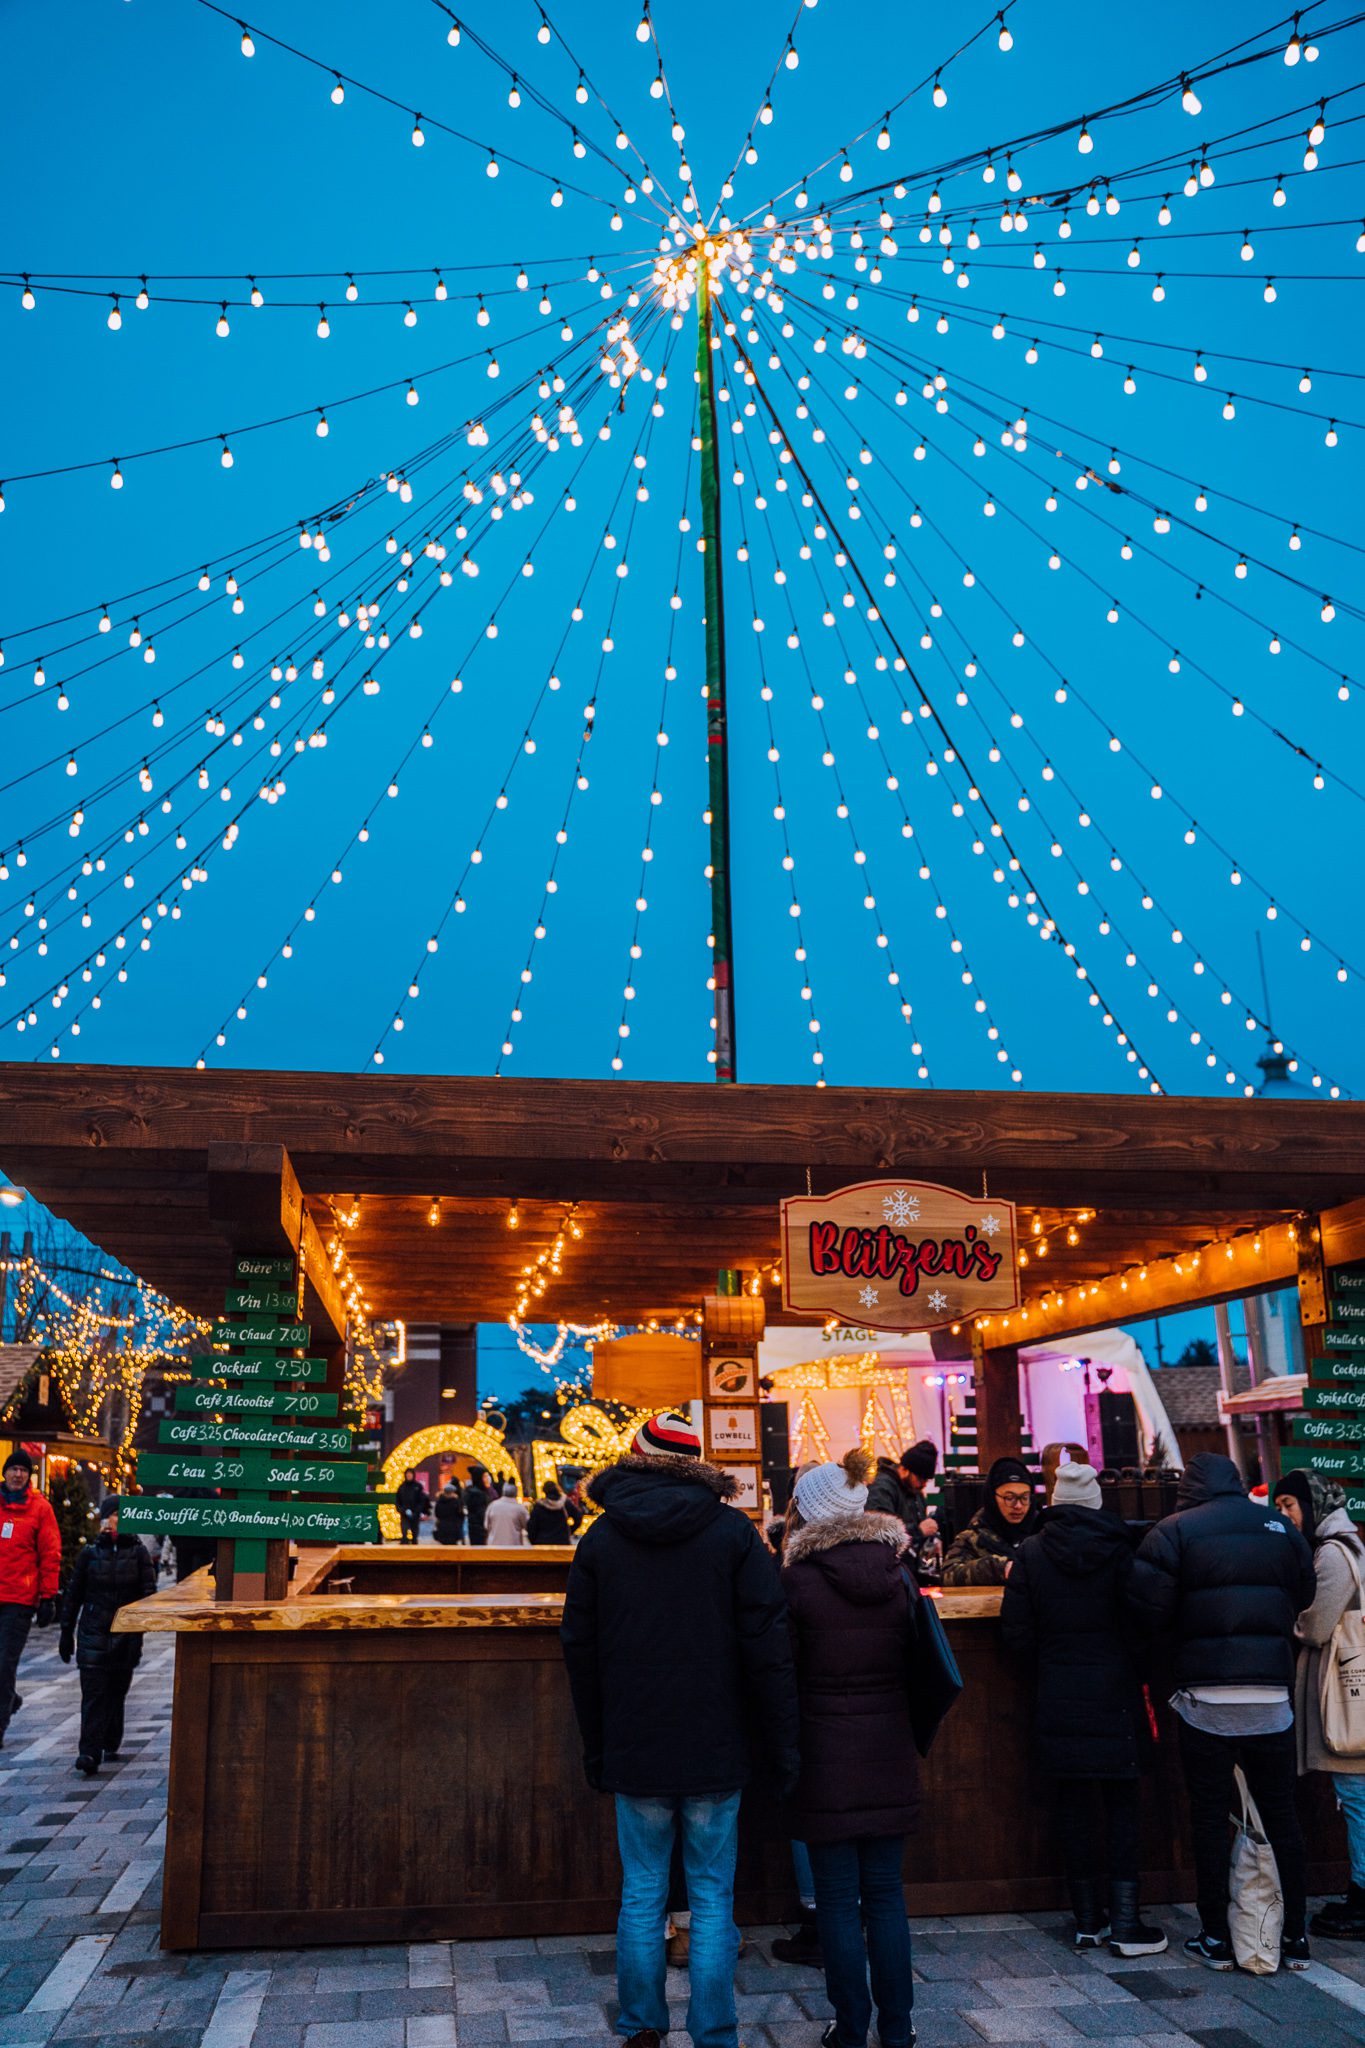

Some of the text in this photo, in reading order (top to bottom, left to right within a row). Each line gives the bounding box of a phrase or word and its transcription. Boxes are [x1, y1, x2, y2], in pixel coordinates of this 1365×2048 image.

[809, 1221, 1002, 1297] Blitzen's
[238, 1260, 272, 1274] Bière
[1338, 1275, 1362, 1287] Beer
[237, 1294, 261, 1309] Vin
[217, 1327, 306, 1342] Vin Chaud 7.00
[1326, 1334, 1357, 1346] Mulled
[212, 1360, 311, 1377] Cocktail 9.50
[195, 1393, 319, 1412] Café Alcoolisé 7.00
[1317, 1392, 1348, 1406] Spiked
[170, 1424, 347, 1449] Café 3.25 Chocolate Chaud 3.50
[714, 1432, 752, 1440] COWBELL
[1304, 1421, 1362, 1439] Coffee 3.25
[1311, 1455, 1345, 1469] Water
[168, 1461, 244, 1480] L'eau 3.50
[267, 1466, 335, 1482] Soda 5.50
[122, 1506, 153, 1521] Maïs
[155, 1508, 199, 1525] Soufflé
[201, 1508, 228, 1526] 5.00
[229, 1511, 280, 1526] Bonbons
[281, 1511, 305, 1529] 4.00
[306, 1513, 340, 1530] Chips
[1350, 1688, 1360, 1697] M
